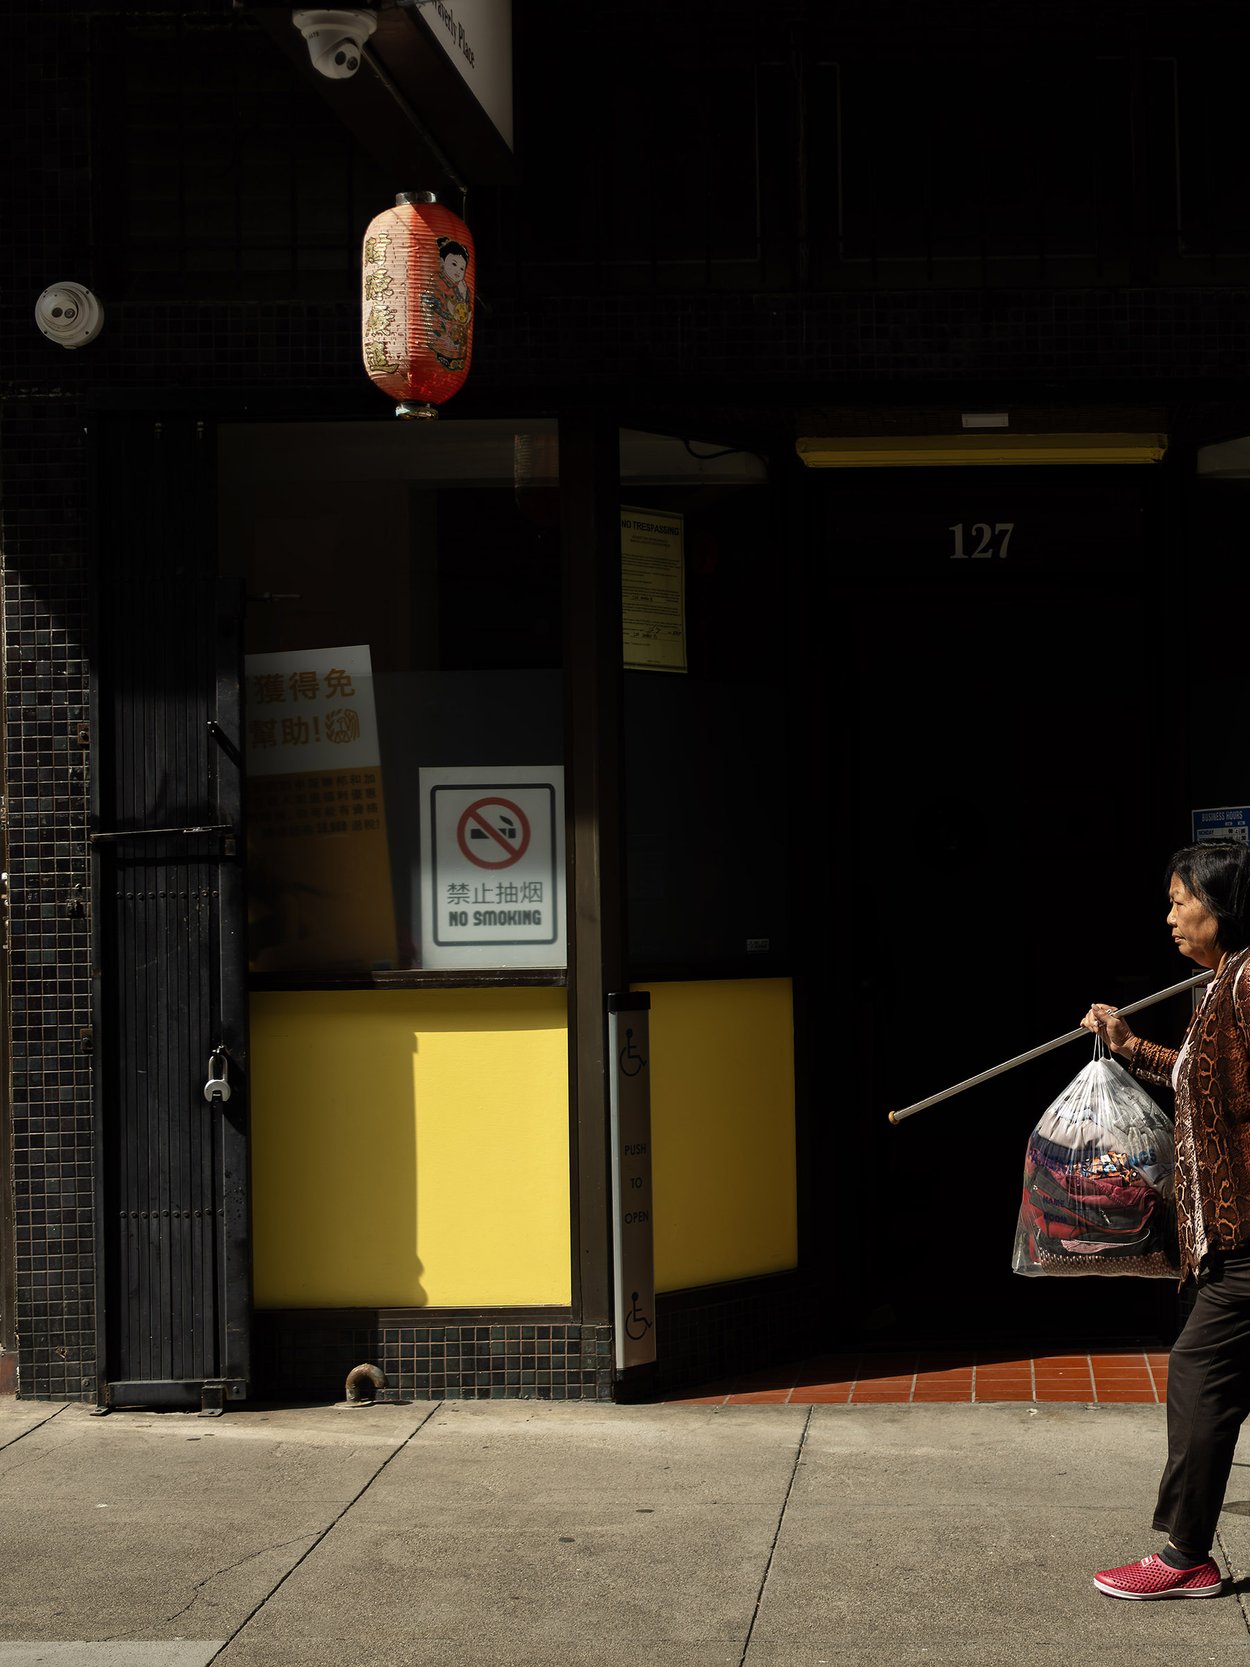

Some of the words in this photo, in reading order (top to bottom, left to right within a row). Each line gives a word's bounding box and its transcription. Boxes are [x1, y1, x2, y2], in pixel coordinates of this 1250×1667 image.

[458, 22, 475, 69] Place
[621, 519, 632, 530] NO
[633, 521, 680, 536] TRESPASSING
[947, 522, 1017, 560] 127
[254, 668, 356, 705] 獲得免
[1202, 812, 1225, 822] BUSINESS
[1226, 810, 1243, 820] HOURS
[446, 881, 544, 906] 禁止抽烟
[449, 911, 468, 927] NO
[473, 910, 542, 927] SMOKING
[624, 1143, 647, 1157] PUSH
[630, 1177, 643, 1189] TO
[624, 1210, 649, 1225] OPEN
